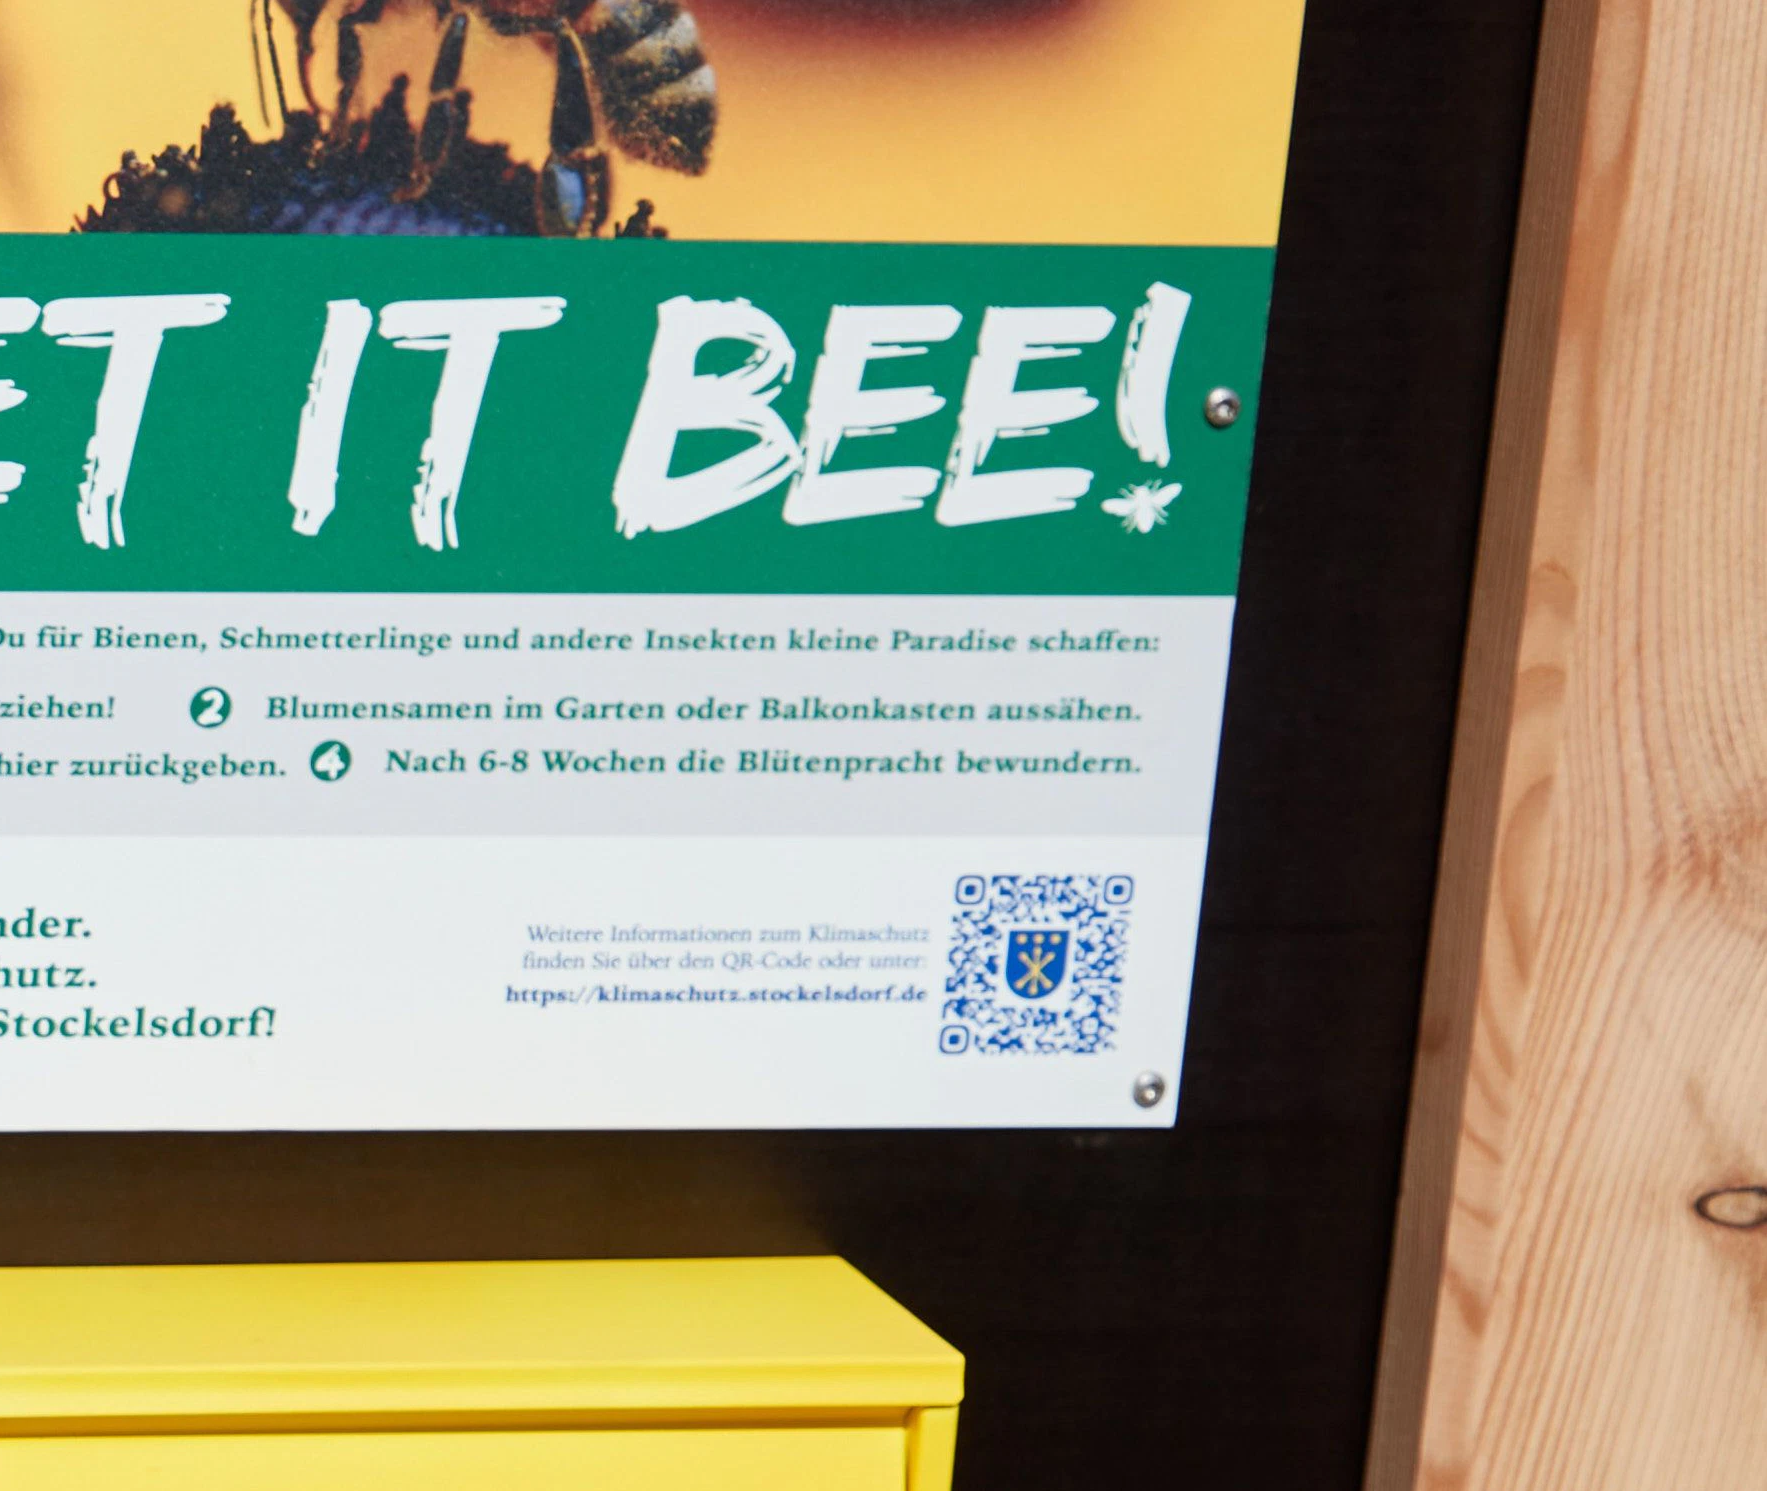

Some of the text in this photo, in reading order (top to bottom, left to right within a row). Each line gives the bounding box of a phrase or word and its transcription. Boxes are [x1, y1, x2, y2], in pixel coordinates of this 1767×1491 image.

[289, 296, 568, 552] IT
[613, 280, 1194, 541] BEE!
[37, 625, 83, 648] für
[94, 625, 207, 651] Bienen,
[220, 626, 452, 657] Schmetterlinge
[464, 627, 520, 650] und
[530, 627, 633, 650] andere
[645, 628, 776, 651] Insekten
[788, 628, 879, 652] kleine
[891, 629, 1017, 652] Paradise
[1029, 629, 1159, 652] schaffen:
[0, 694, 115, 719] ziehen!
[267, 695, 492, 720] Blumensamen
[505, 695, 543, 719] im
[555, 696, 665, 720] Garten
[676, 696, 749, 720] oder
[760, 696, 975, 721] Balkonkasten
[987, 697, 1141, 721] aussähen.
[70, 753, 286, 784] zurückgeben.
[387, 749, 466, 773] Nach
[479, 750, 528, 773] 6-8
[542, 749, 666, 773] Wochen
[677, 749, 725, 773] die
[737, 749, 943, 781] Blütenpracht
[956, 749, 1141, 774] bewundern.
[527, 924, 930, 943] Weitere Informationen zum Klimaschutz
[522, 950, 586, 970] finden
[592, 952, 622, 970] Sie
[628, 951, 672, 970] über
[677, 951, 715, 970] den
[721, 951, 812, 973] QR-Code
[817, 951, 862, 970] oder
[506, 985, 927, 1008] https://klimaschutz.stockelsdorf.de
